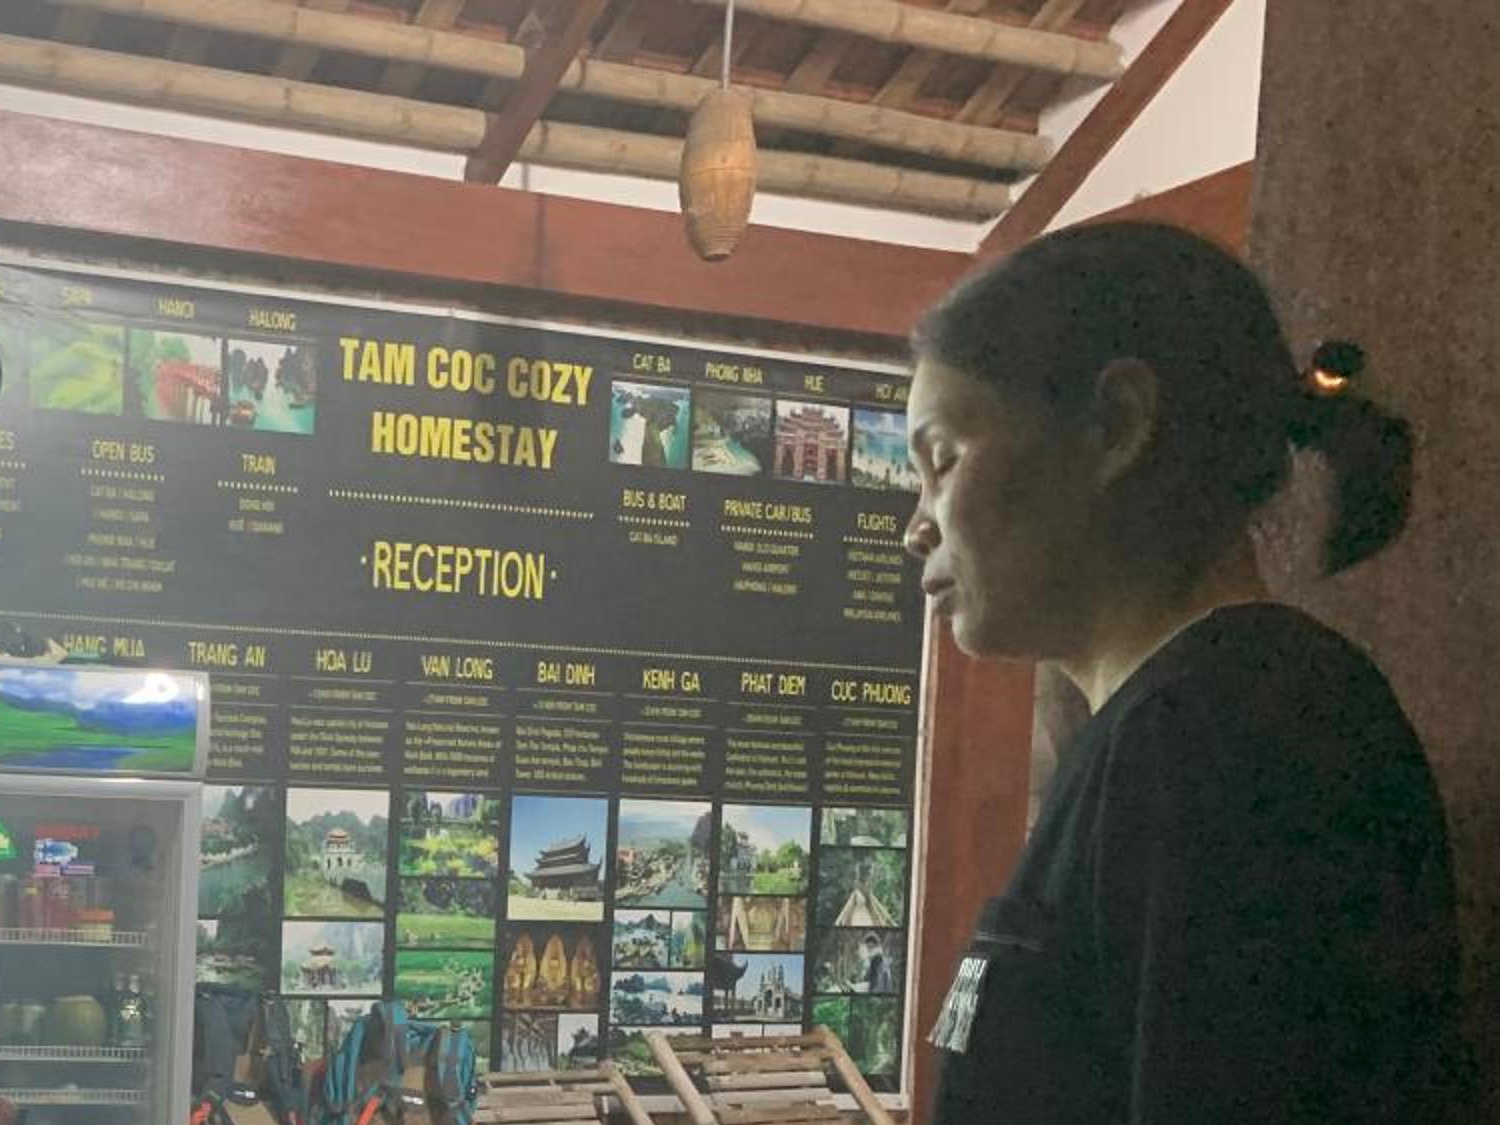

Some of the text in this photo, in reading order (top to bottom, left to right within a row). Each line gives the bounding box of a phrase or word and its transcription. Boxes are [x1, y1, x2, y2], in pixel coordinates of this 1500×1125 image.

[339, 336, 594, 406] TAM COC COZY
[632, 352, 672, 374] CAT BA
[91, 439, 156, 464] OPEN BUS
[371, 410, 558, 469] HOMESTAY
[241, 452, 276, 477] TRAIN
[622, 488, 645, 509] BUS
[658, 491, 688, 513] BOAT
[723, 499, 764, 521] PRIVATE
[856, 511, 898, 532] FLIGHTS
[372, 540, 546, 600] RECEPTION
[187, 640, 268, 668] TRANG AN
[315, 648, 372, 674] HOA LU
[420, 654, 494, 682] VAN LONG
[536, 660, 597, 687] BAI DINH
[642, 668, 701, 692] KENH GA
[740, 671, 806, 697] PHAT DIEM
[831, 678, 912, 705] CUC PHUONG
